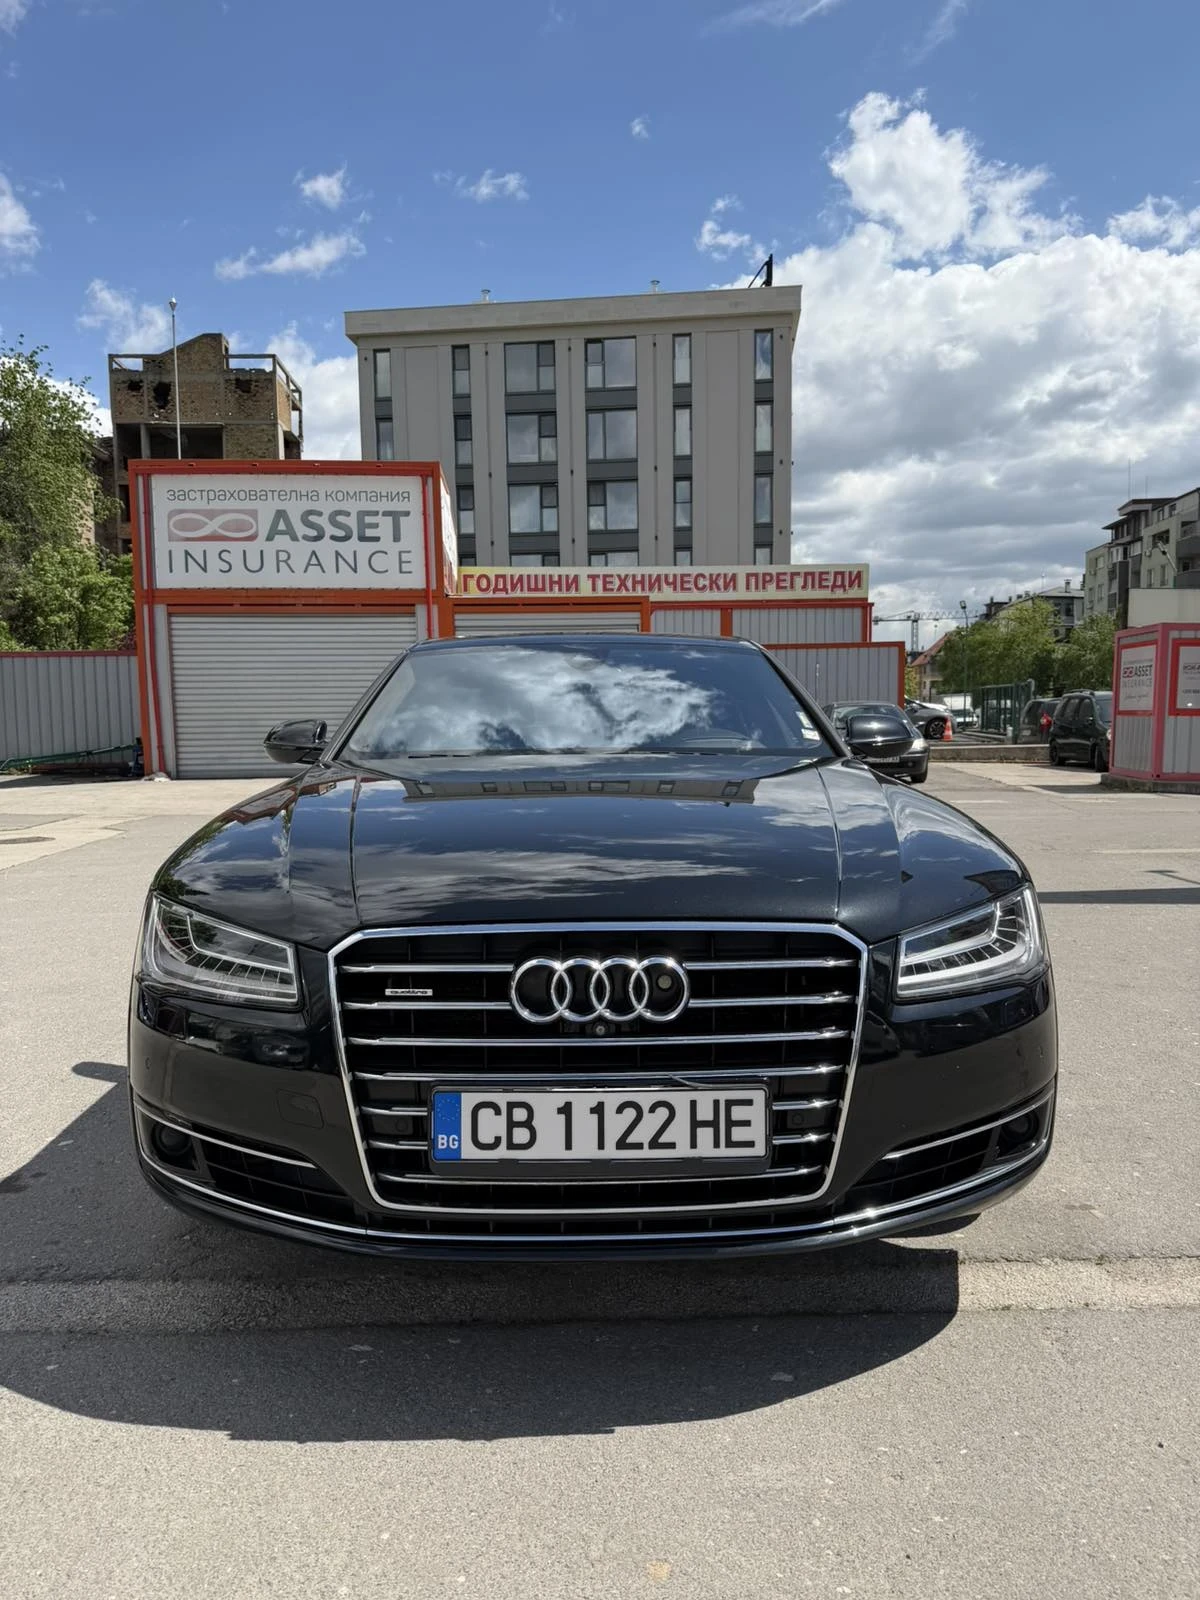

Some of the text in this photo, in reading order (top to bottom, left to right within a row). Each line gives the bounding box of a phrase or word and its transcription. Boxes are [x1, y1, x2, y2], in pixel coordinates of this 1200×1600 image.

[167, 488, 411, 504] застрахователна компания
[266, 509, 411, 542] ASSET
[168, 549, 413, 575] INSURANCE
[462, 570, 863, 594] ГОДИШНИ ТЕХНИЧЕСКИ ПРЕГЛЕДИ
[556, 1100, 677, 1151] 1122
[437, 1134, 459, 1149] BG
